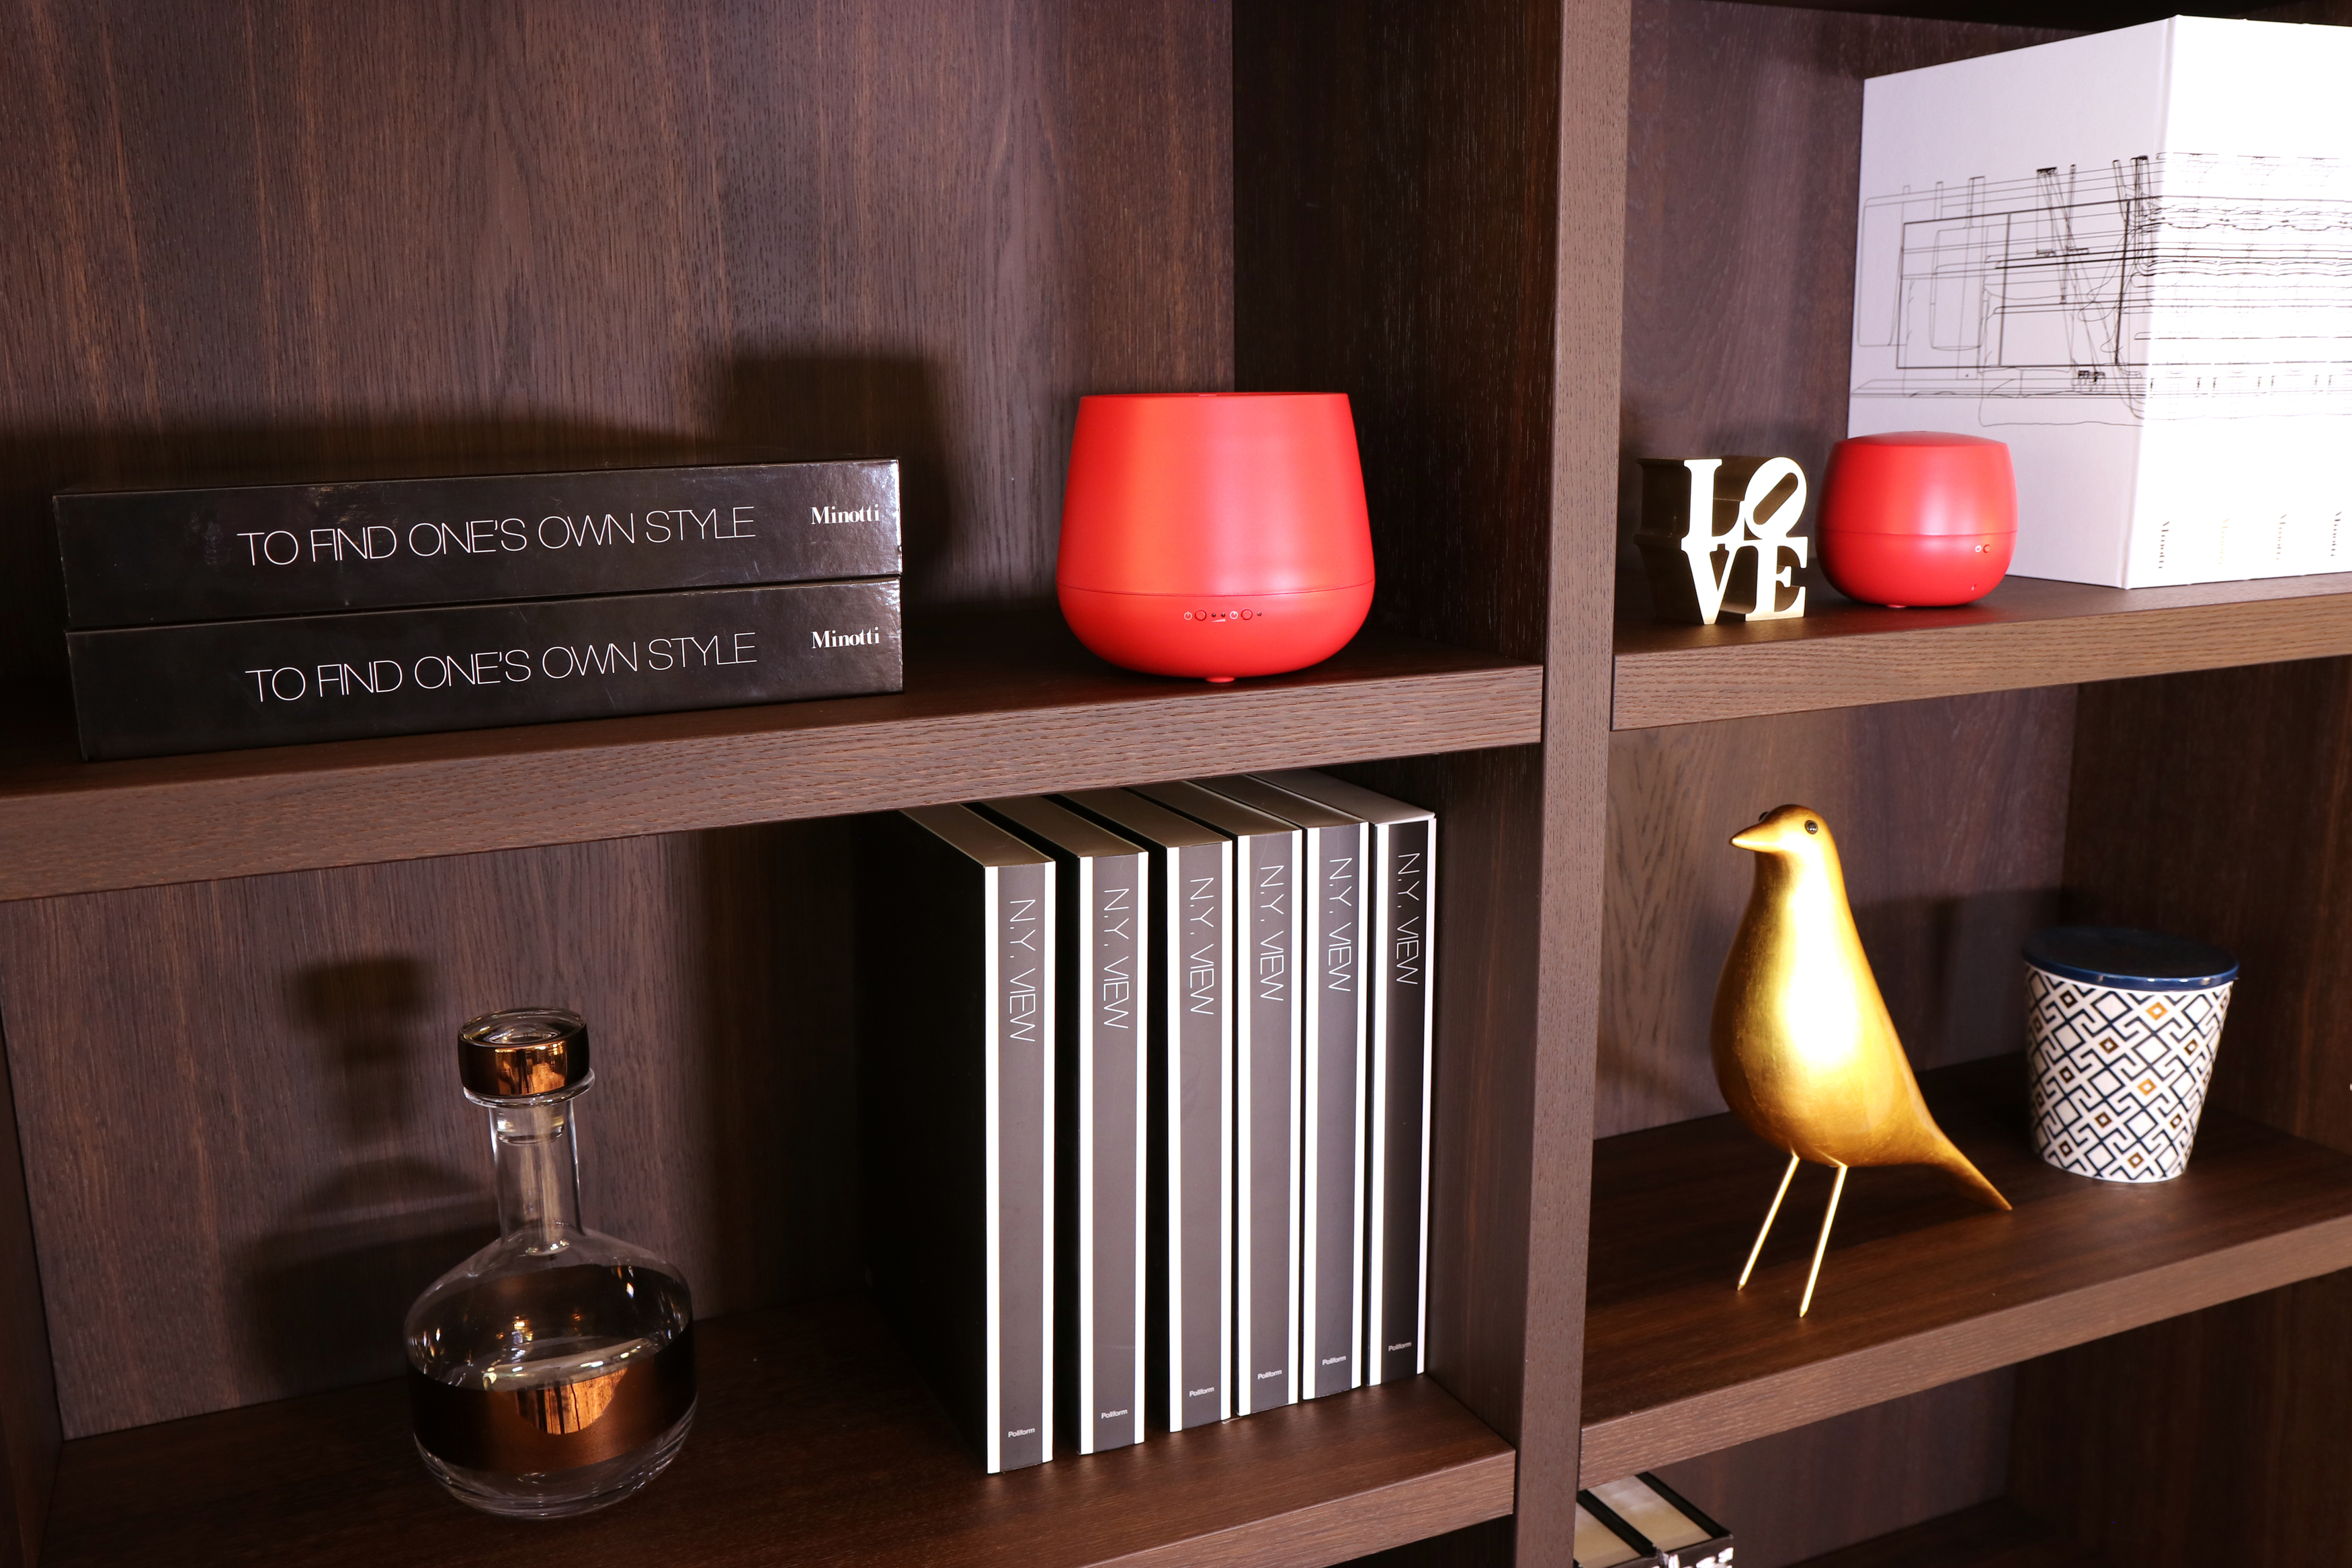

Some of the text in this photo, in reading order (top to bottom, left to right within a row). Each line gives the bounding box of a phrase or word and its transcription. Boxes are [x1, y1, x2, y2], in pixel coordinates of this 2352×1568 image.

[810, 503, 880, 525] Minotti
[237, 506, 756, 566] TO FIND ONE'S OWN STYLE
[811, 626, 880, 649] Minotti
[245, 632, 757, 703] TO FIND ONE'S OWN STYLE
[1260, 865, 1284, 1001] N.Y. VIEW
[1328, 857, 1353, 992] N.Y. VIEW
[1396, 853, 1421, 985] N.Y. VIEW
[1103, 888, 1130, 1029] N.Y. VIEW
[1189, 877, 1214, 1015] N.Y. VIEW
[1009, 899, 1036, 1042] N.Y. VIEW
[1322, 1356, 1347, 1366] Poliform
[1388, 1342, 1412, 1352] Poliform
[1189, 1387, 1215, 1397] Poliform
[1257, 1369, 1282, 1380] Poliform
[1008, 1428, 1036, 1438] Poliform
[1101, 1409, 1128, 1419] Poliform
